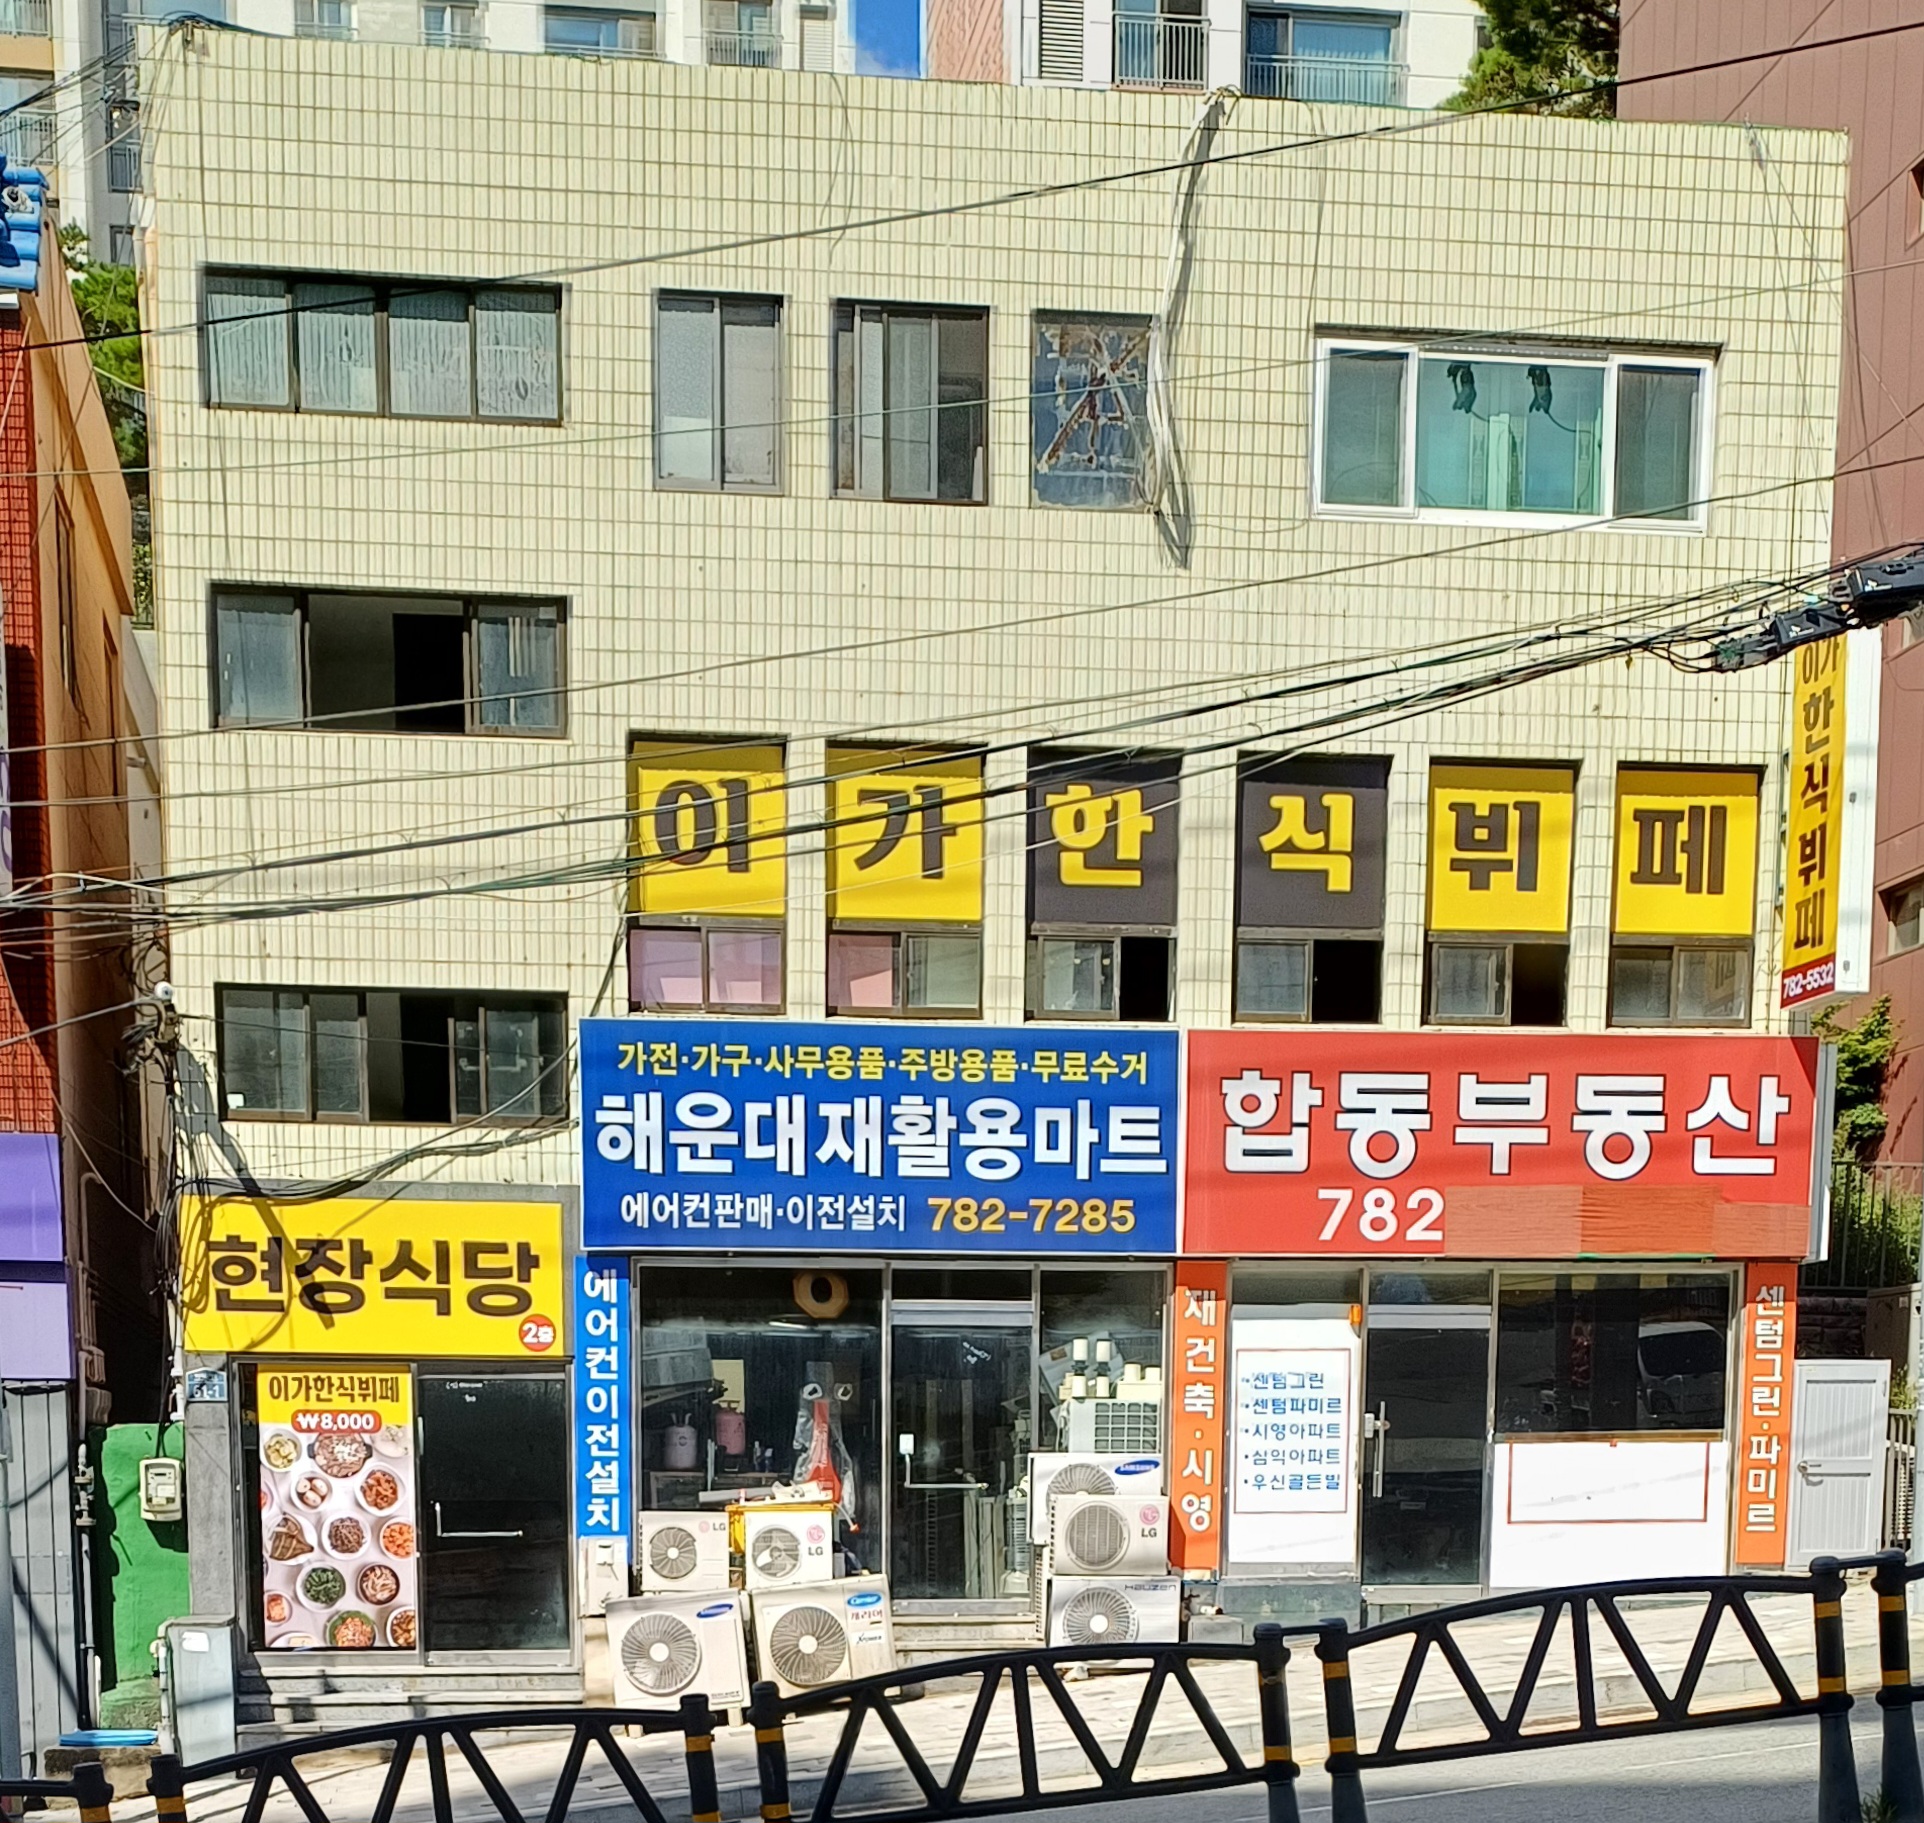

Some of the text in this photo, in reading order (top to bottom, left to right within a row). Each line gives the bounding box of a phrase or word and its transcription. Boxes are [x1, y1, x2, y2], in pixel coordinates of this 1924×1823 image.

[1783, 961, 1834, 999] 782-5532
[1220, 1068, 1792, 1180] 합동부동산
[594, 1090, 1168, 1180] 해운대재활용마트
[620, 1192, 1136, 1233] 에어컨판매·이전설치 782-7285
[206, 1234, 540, 1317] 현장식당
[269, 1375, 399, 1402] 이가한식뷔페
[1253, 1371, 1324, 1389] 센텀그린
[193, 1384, 219, 1398] 61-1
[583, 1268, 620, 1533] 에어컨이전설치
[1253, 1398, 1342, 1415] 센텀파미르
[296, 1412, 375, 1430] ₩8,000
[1252, 1423, 1341, 1440] 시영아파트
[1252, 1474, 1340, 1490] 우신골든빌
[713, 1523, 726, 1531] LG
[1141, 1529, 1157, 1538] LG
[808, 1546, 823, 1556] LG
